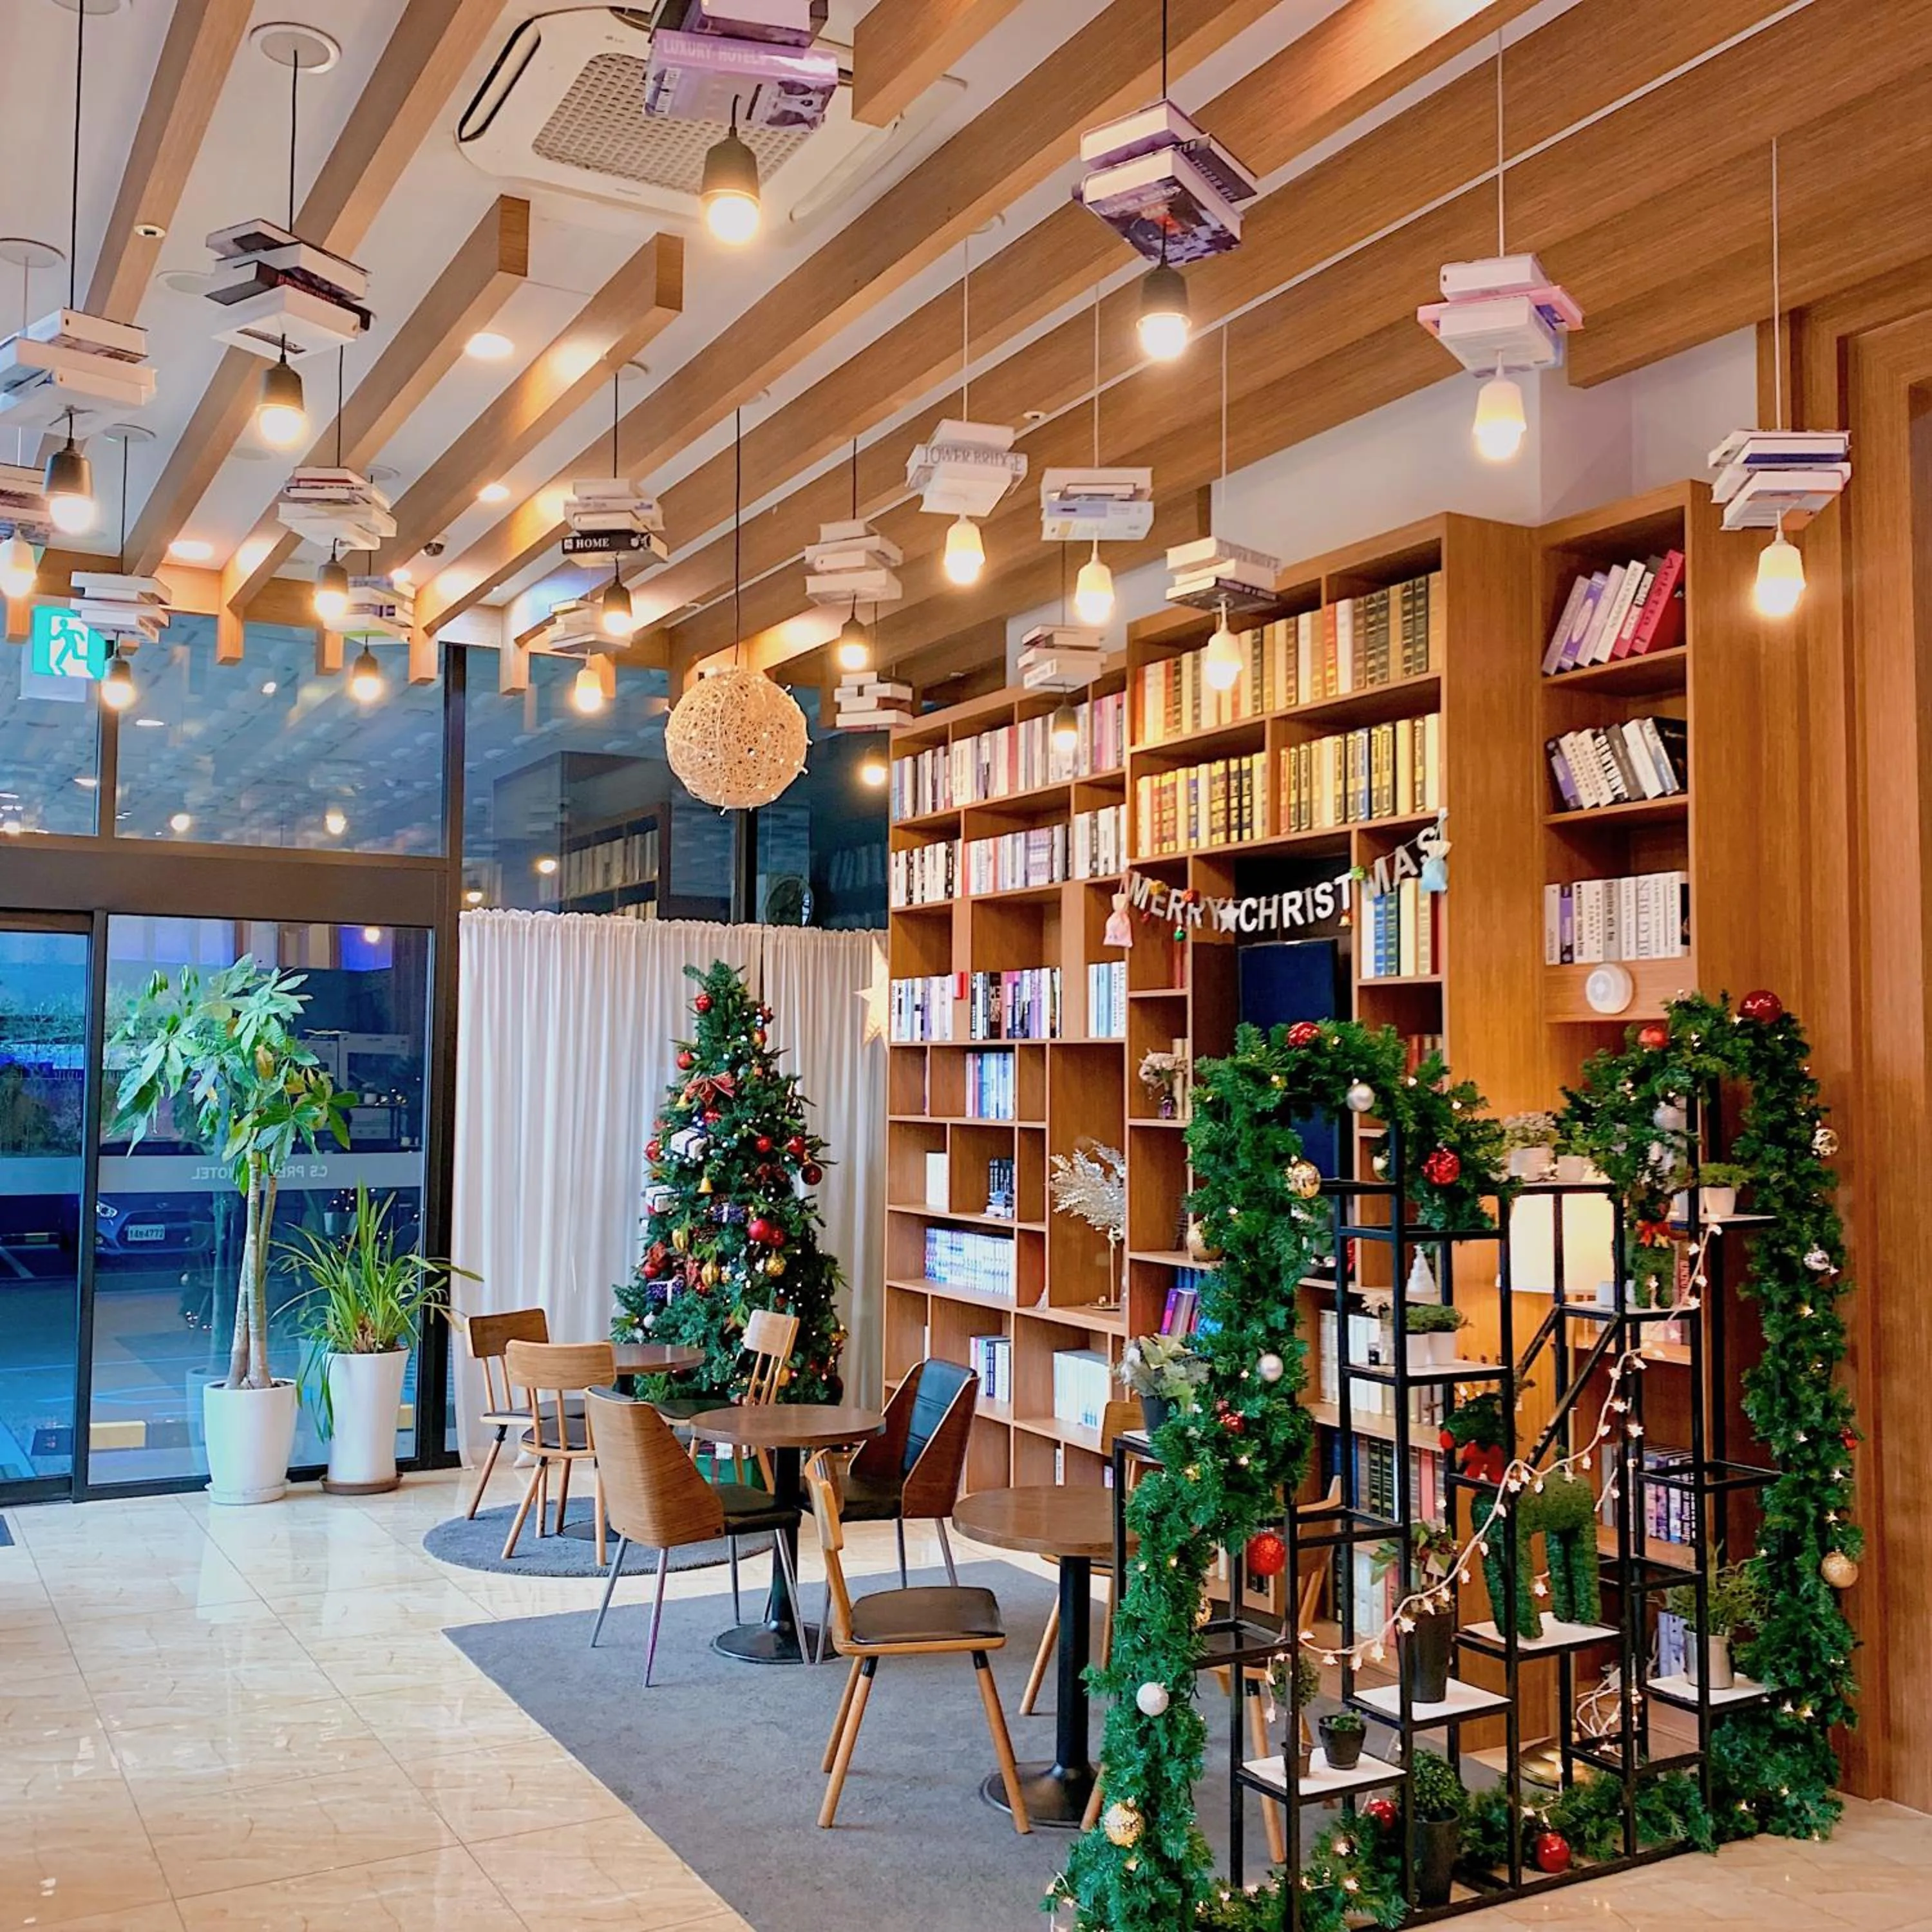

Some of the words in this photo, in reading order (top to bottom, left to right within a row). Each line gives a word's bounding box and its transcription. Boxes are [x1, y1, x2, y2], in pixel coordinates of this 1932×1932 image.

[663, 39, 712, 59] LUXURY
[923, 444, 970, 464] TOWER
[576, 537, 610, 548] HOME
[1128, 871, 1222, 929] MERRY
